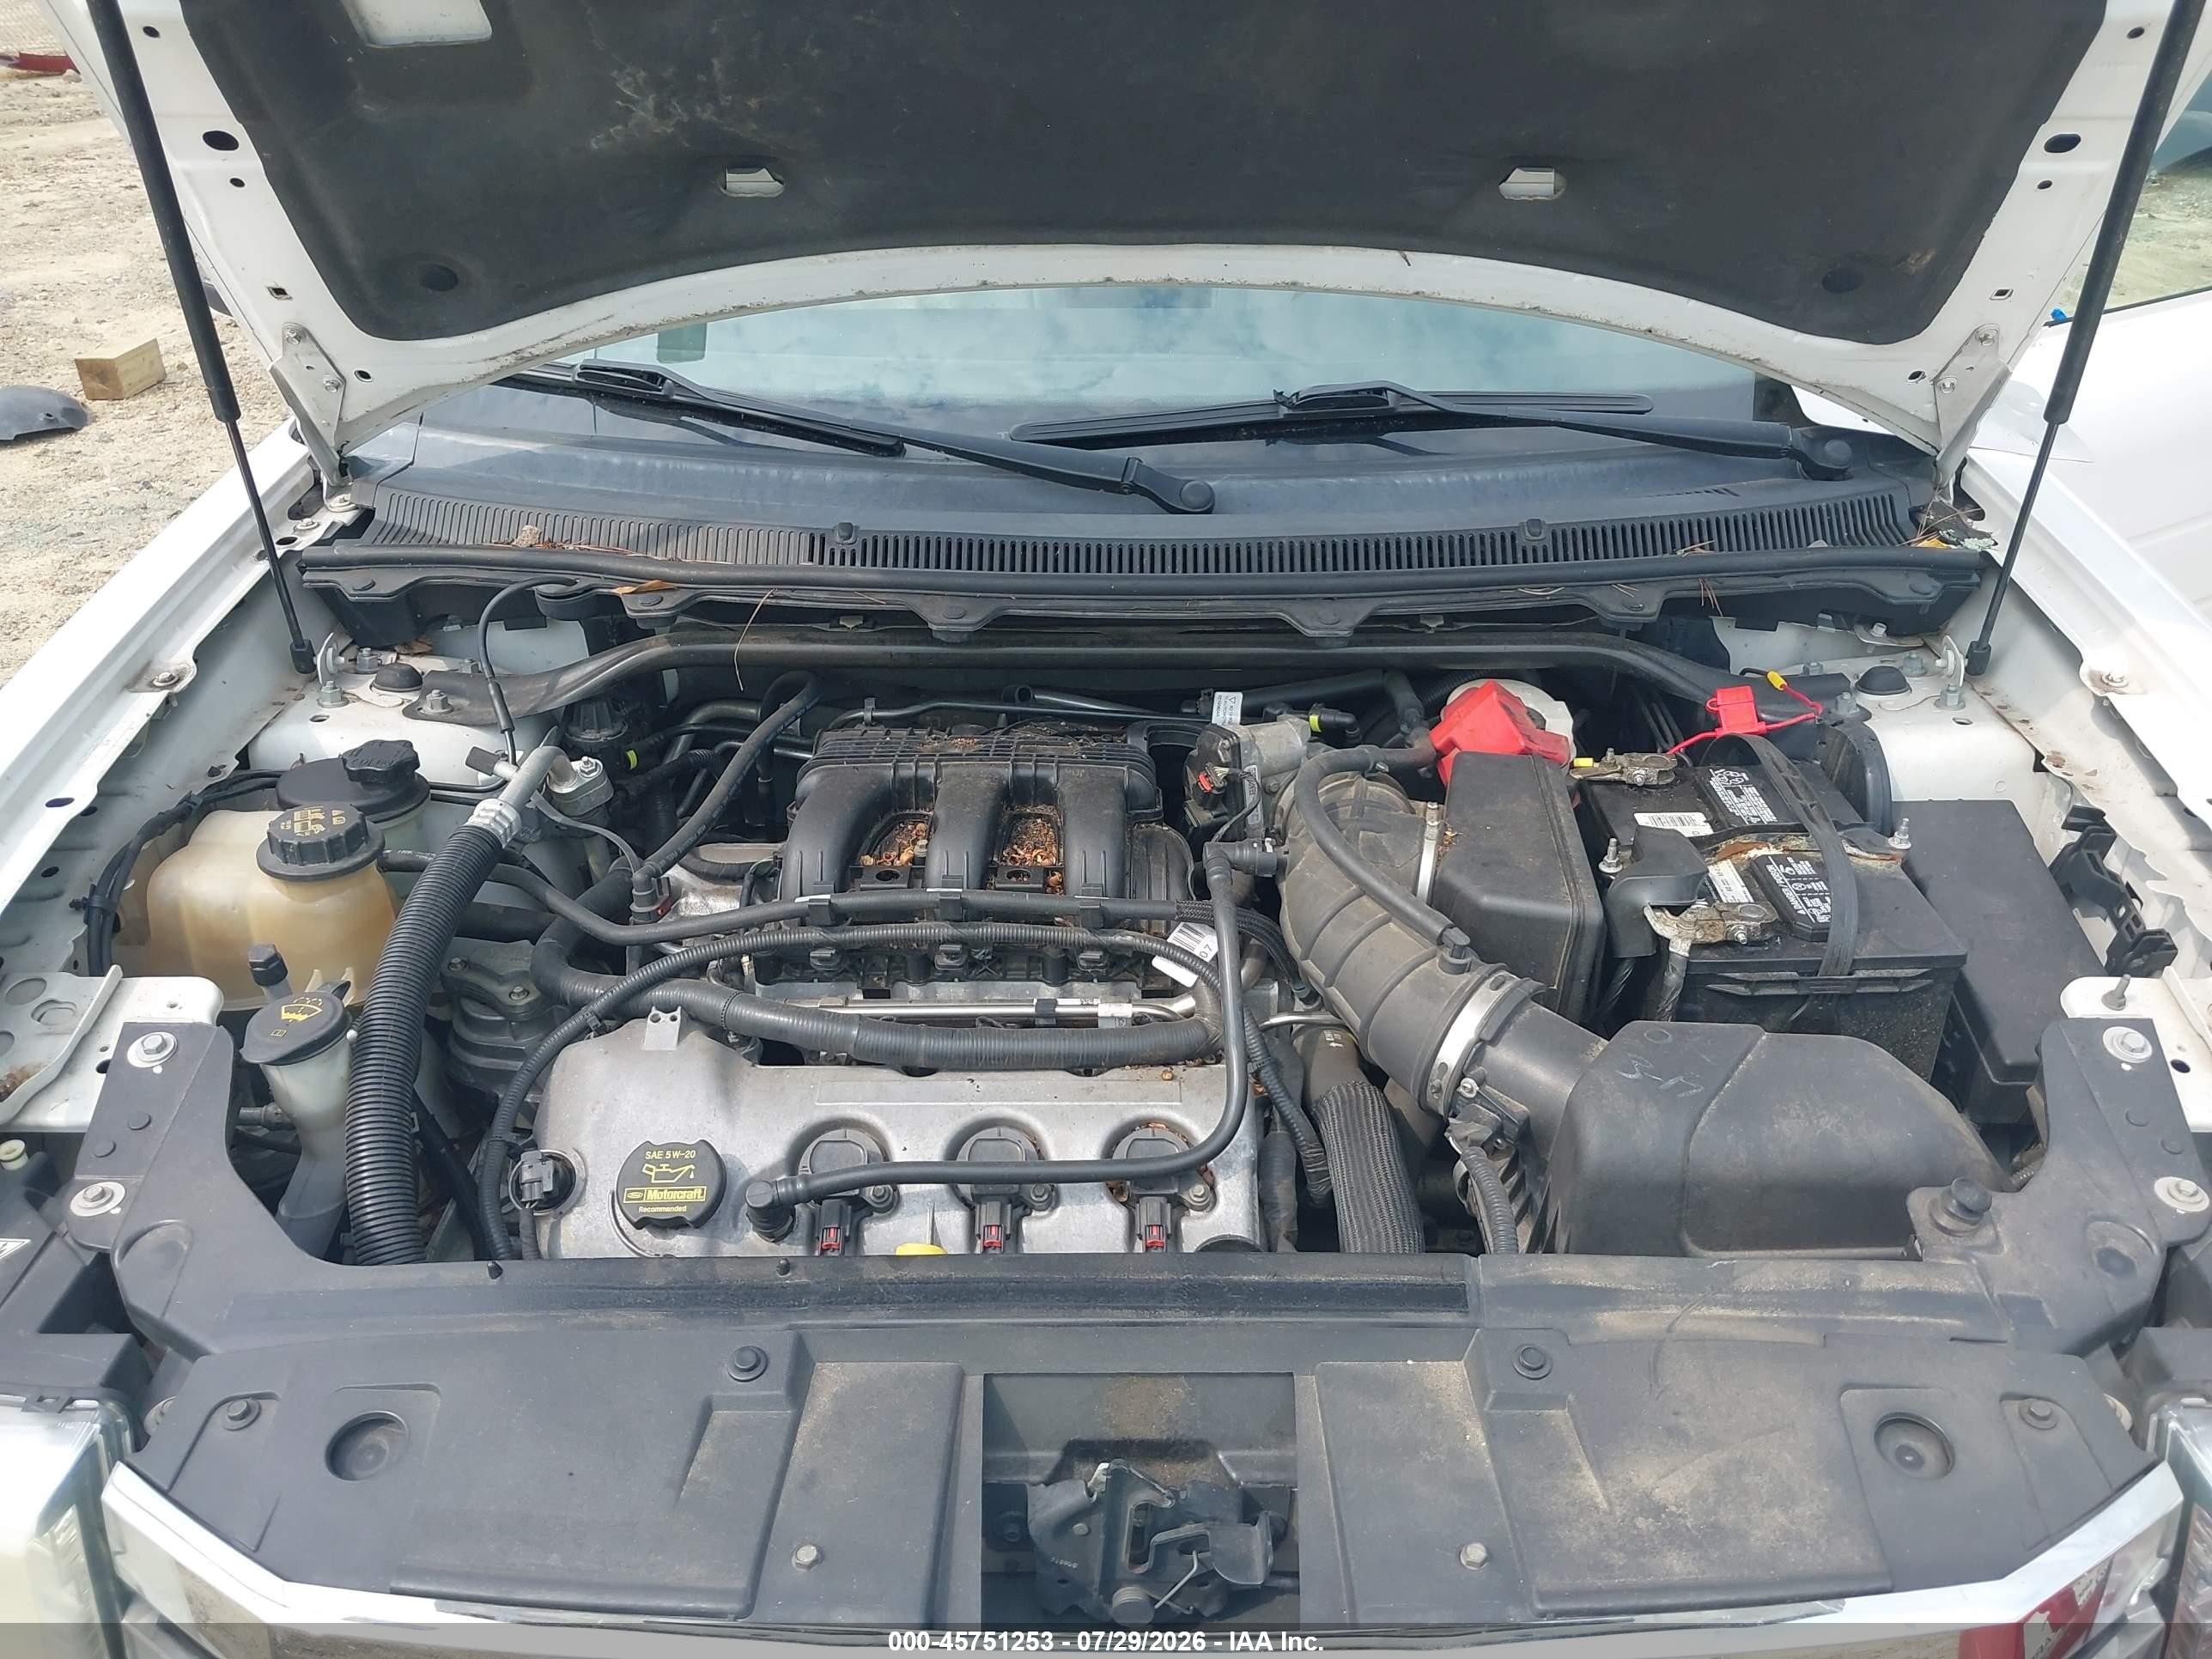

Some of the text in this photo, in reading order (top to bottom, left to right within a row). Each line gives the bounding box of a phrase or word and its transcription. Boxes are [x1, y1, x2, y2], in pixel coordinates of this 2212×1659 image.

[645, 1151, 663, 1160] SAE
[647, 1188, 703, 1200] Motorcraft
[638, 1205, 688, 1213] Recommended
